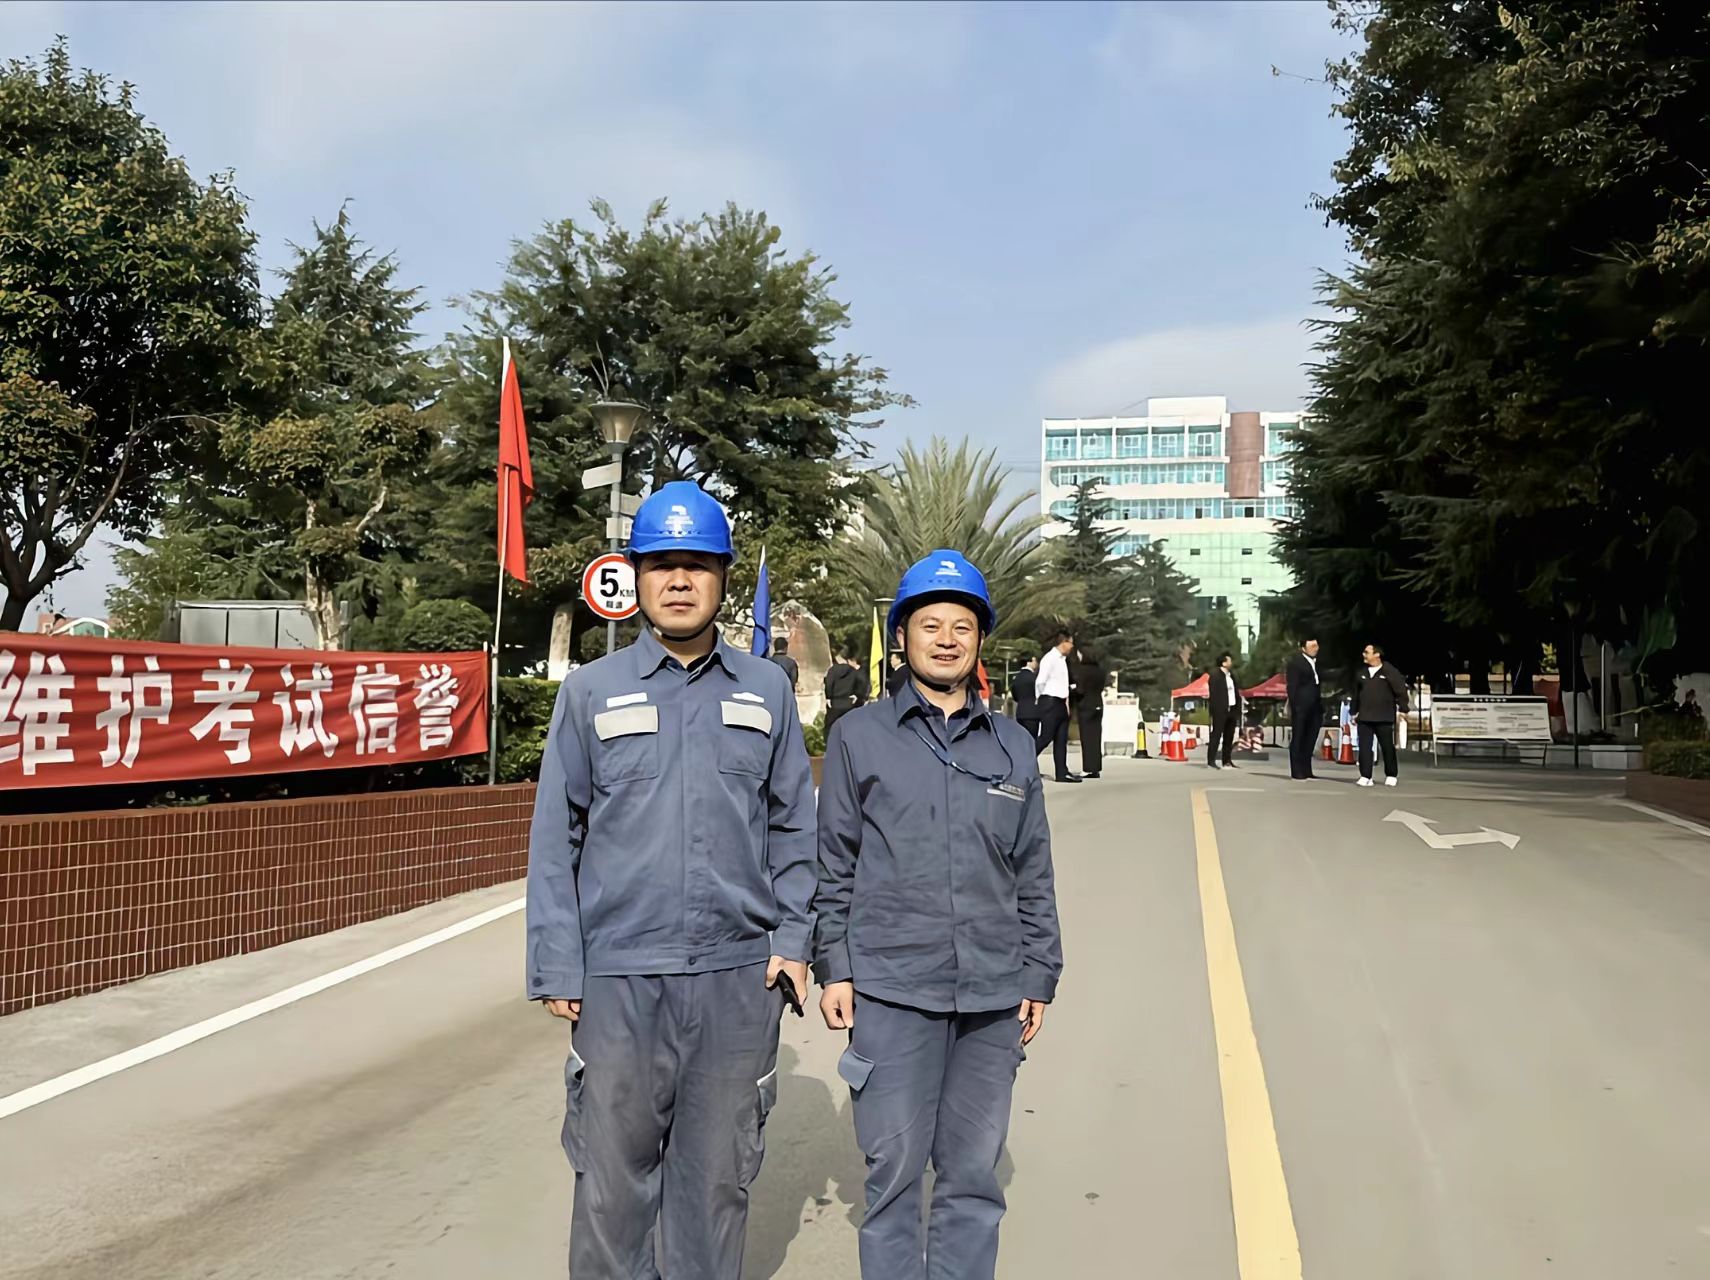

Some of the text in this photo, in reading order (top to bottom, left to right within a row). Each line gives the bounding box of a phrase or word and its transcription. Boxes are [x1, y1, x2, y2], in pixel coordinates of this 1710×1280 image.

[600, 568, 619, 597] 5
[0, 649, 459, 775] 维护考试信誉
